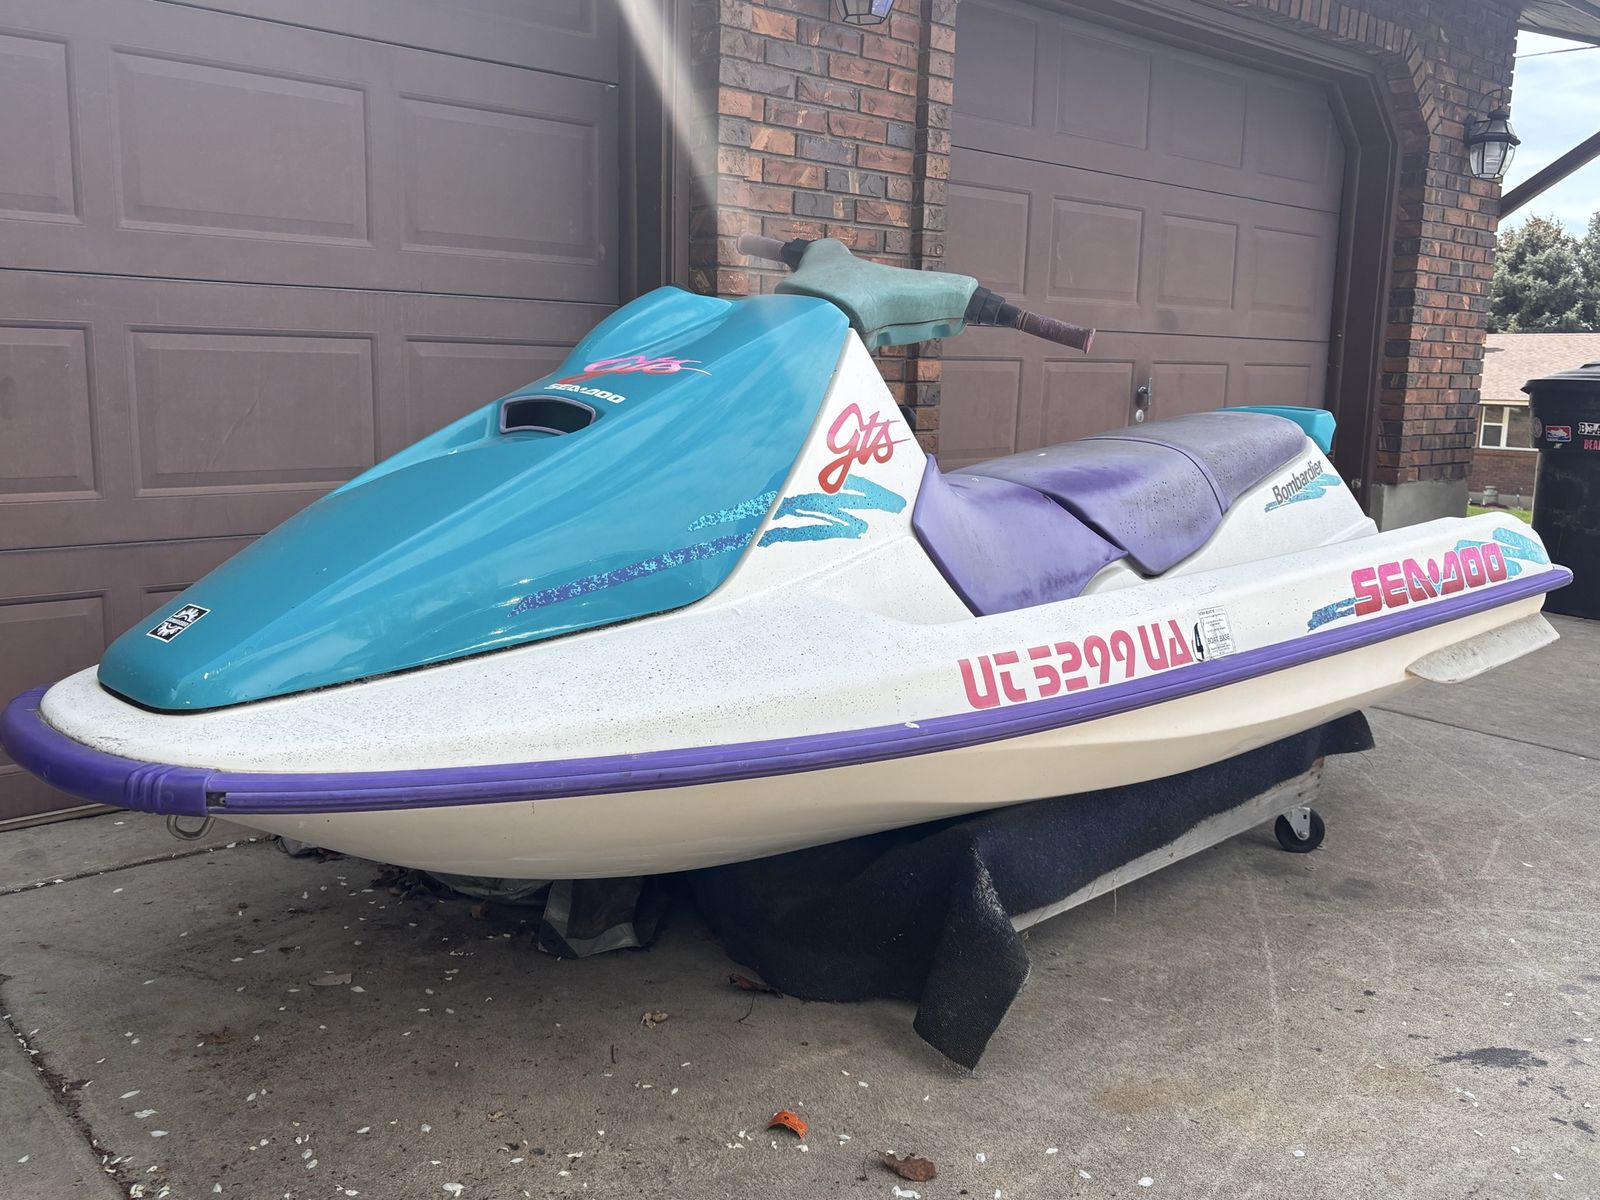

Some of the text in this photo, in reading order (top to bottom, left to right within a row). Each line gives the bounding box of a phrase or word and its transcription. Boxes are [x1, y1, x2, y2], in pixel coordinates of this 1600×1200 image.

[1272, 460, 1324, 505] Bombardier
[957, 619, 1194, 710] UT 5299 UA
